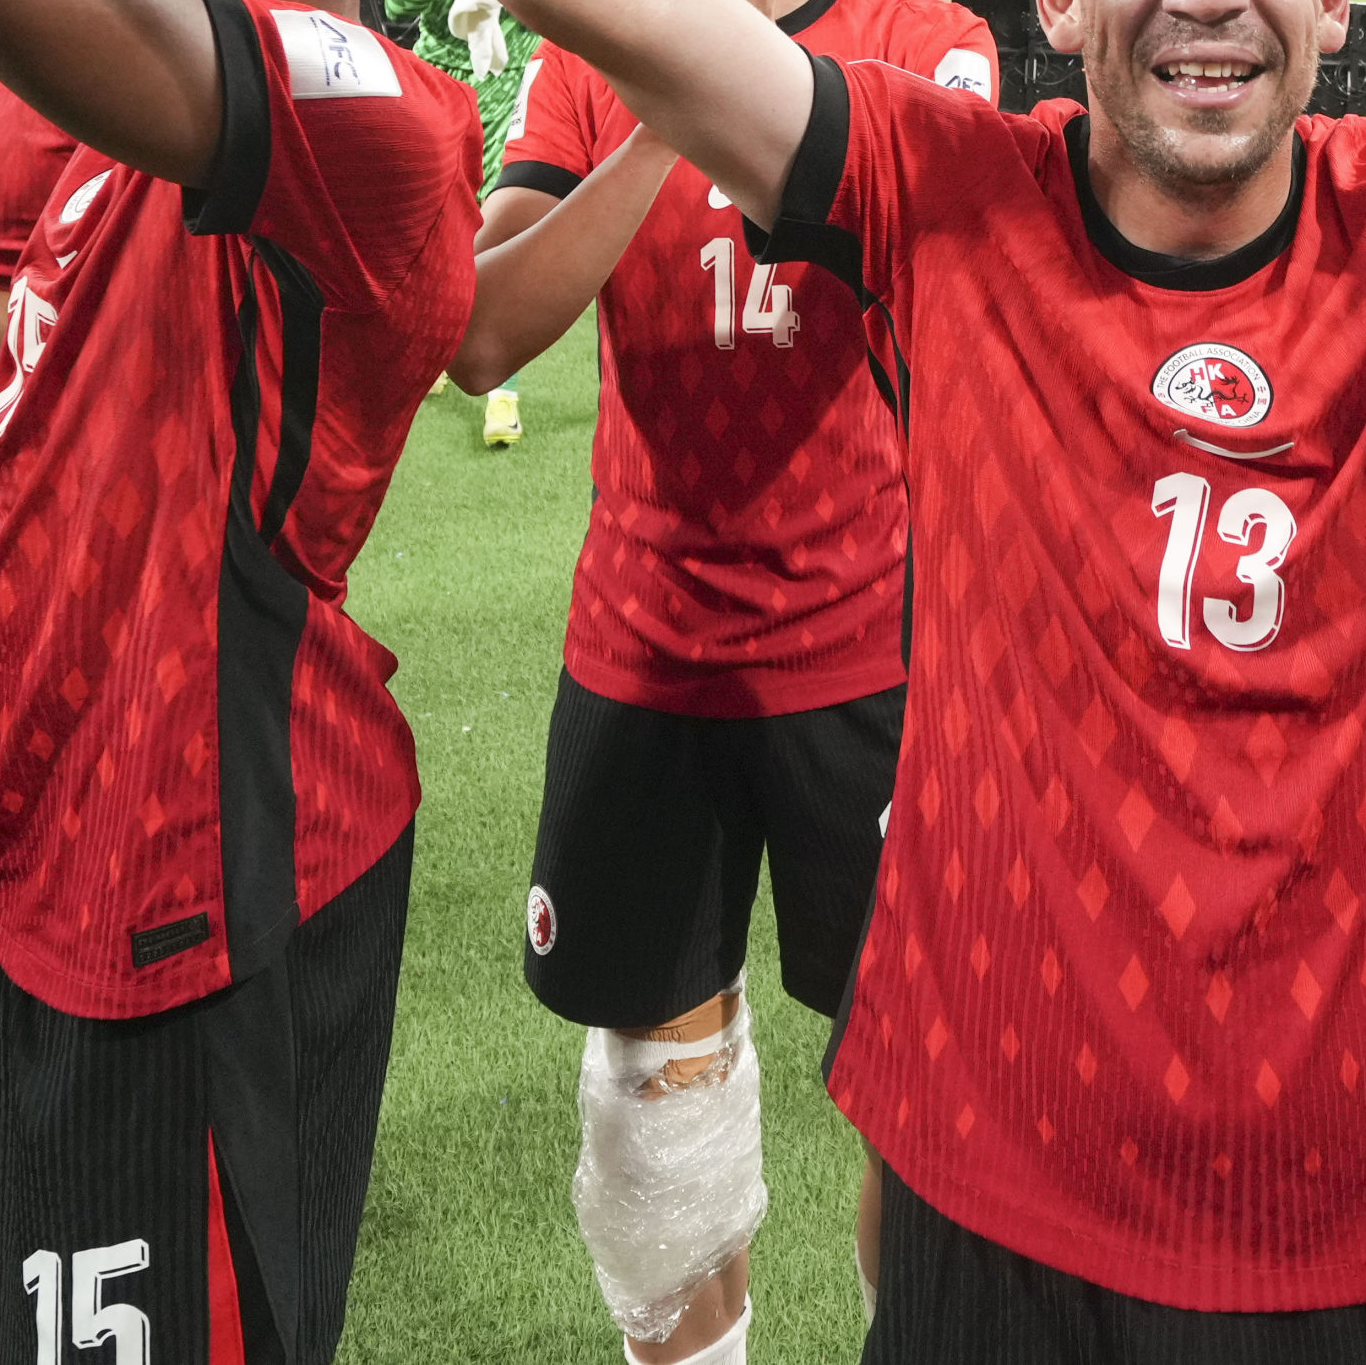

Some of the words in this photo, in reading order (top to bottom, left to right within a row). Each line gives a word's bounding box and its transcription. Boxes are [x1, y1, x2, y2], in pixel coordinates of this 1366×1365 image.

[320, 18, 359, 80] AFC
[700, 237, 800, 350] 14
[1157, 376, 1167, 388] THE
[1164, 347, 1203, 377] FOOTBALL
[1206, 346, 1262, 381] ASSOCIATION
[1151, 472, 1297, 652] 13
[22, 1238, 151, 1365] 15
